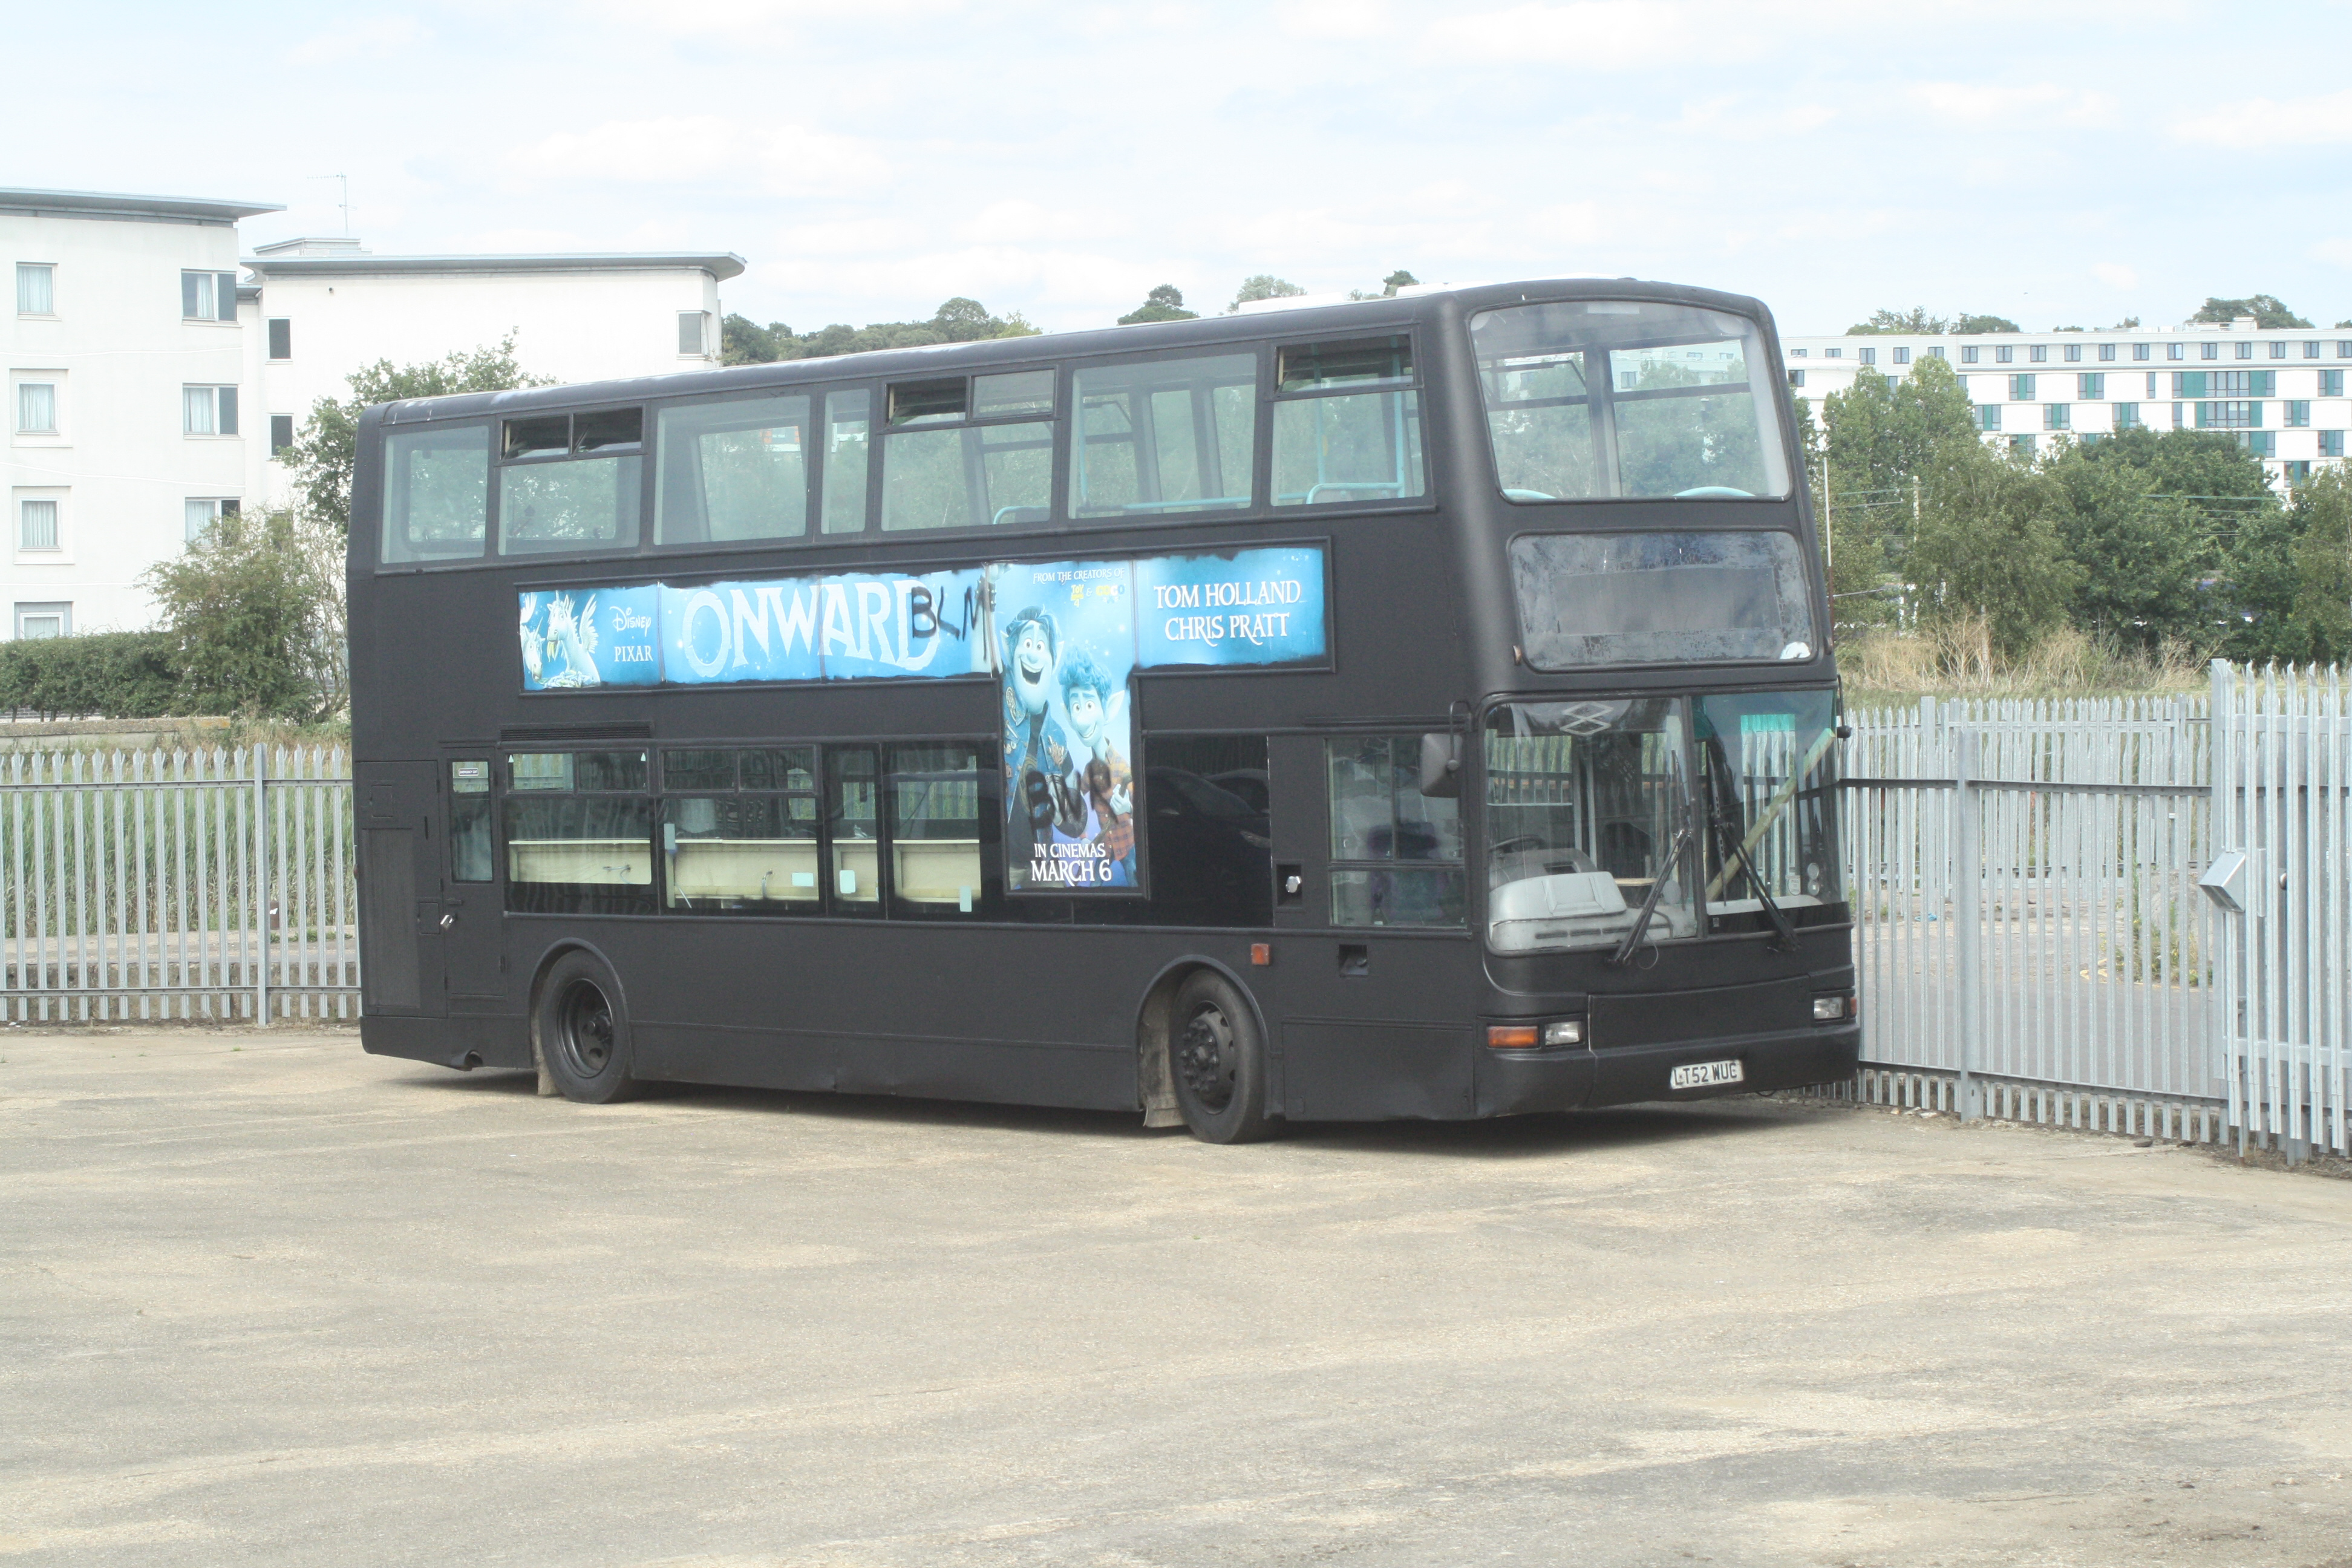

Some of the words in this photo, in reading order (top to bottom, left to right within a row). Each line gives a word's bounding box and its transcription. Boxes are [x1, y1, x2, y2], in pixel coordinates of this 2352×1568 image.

[1033, 572, 1056, 584] FROM
[1057, 570, 1072, 585] THE
[1073, 568, 1112, 582] CREATORS
[1114, 567, 1126, 579] OF
[1071, 584, 1085, 594] TOY
[1153, 584, 1200, 609] TOM
[1204, 580, 1301, 607] HOLLAND
[682, 580, 939, 678] ONWARD
[911, 584, 987, 662] BLM
[1165, 615, 1225, 647] CHRIS
[1229, 612, 1290, 645] PRATT
[613, 645, 654, 662] PIXAR
[1034, 843, 1047, 858] IN
[1050, 842, 1106, 858] CINEMAS
[1030, 860, 1096, 887] MARCH
[1099, 858, 1112, 881] 6
[1673, 1066, 1709, 1086] LT52
[1711, 1062, 1737, 1081] WUC
